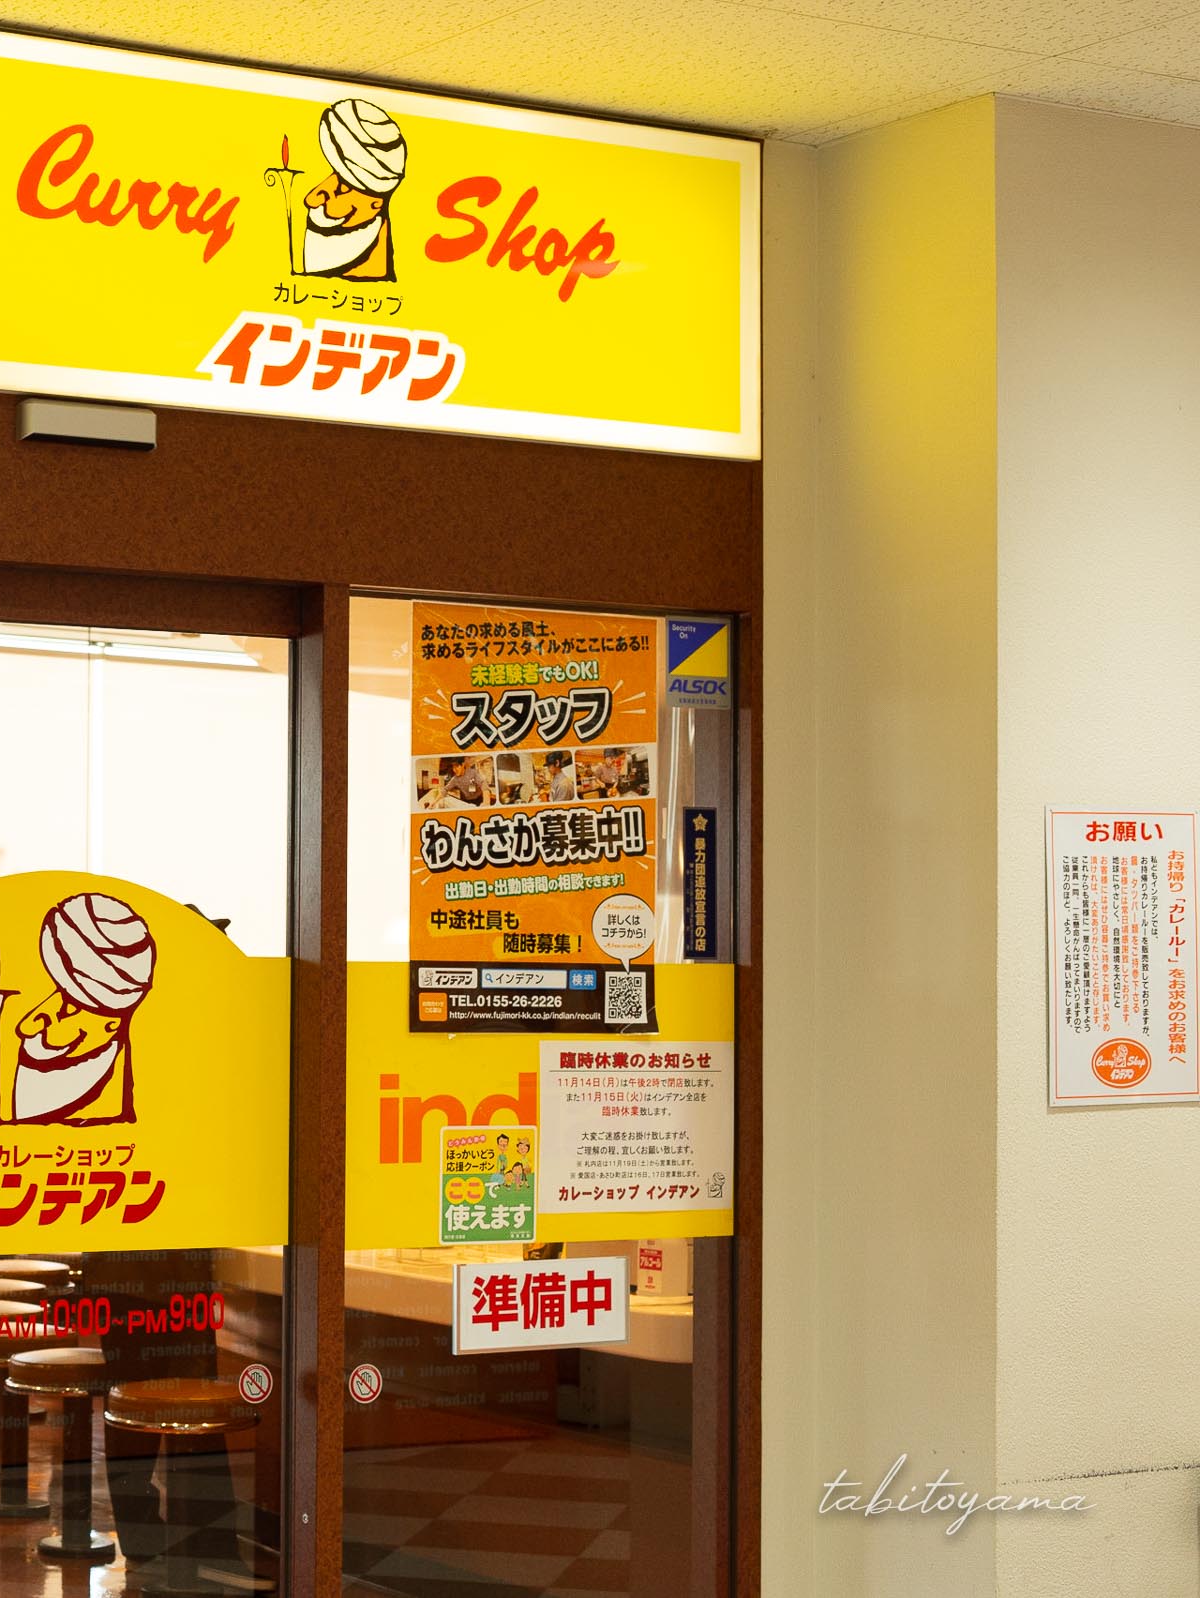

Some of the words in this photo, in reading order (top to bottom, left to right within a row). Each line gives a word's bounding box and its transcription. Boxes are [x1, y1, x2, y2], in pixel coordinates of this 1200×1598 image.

[17, 124, 240, 263] Curry
[425, 176, 621, 302] Shop
[273, 282, 403, 316] カレーショップ
[212, 322, 455, 401] インデアン
[421, 621, 556, 641] あなたの求める風土、
[672, 624, 696, 632] Security
[421, 636, 649, 659] 求めるライフスタイルがここにある!!
[471, 661, 599, 687] 未経験者でもOK!
[669, 679, 727, 695] ALSOK
[451, 688, 612, 748] スタッフ
[420, 806, 646, 871] わんさか募集中!!
[1085, 821, 1163, 842] お願い
[445, 874, 625, 900] 出勤日・出勤時間の相談できます!
[430, 909, 519, 930] 中途社員も
[607, 914, 640, 925] 詳しくは
[602, 928, 646, 938] コチラから!
[503, 934, 582, 953] 随時募集！
[435, 975, 473, 985] インデアン
[495, 972, 544, 985] インデアン
[572, 973, 594, 986] 検索
[449, 995, 562, 1008] TEL.0155-26-2226
[559, 1052, 712, 1069] 臨時休業のお知らせ
[557, 1077, 714, 1088] 11月14日(月)は午後2時で閉店致します。
[566, 1091, 708, 1102] また11月15日(火)はインデアン全店を
[601, 1106, 671, 1117] 臨時休業致します。
[581, 1130, 689, 1141] 大変ご迷惑をお掛け致しますが、
[446, 1149, 495, 1160] ほっかいどう
[576, 1145, 694, 1155] ご理解の程、宜しくお願い致します。
[446, 1161, 495, 1172] 応援クーポン
[449, 1182, 499, 1199] ここで
[558, 1185, 639, 1201] カレーショップ
[646, 1184, 700, 1199] インデアン
[445, 1204, 532, 1232] 使えます
[471, 1270, 612, 1332] 準備中
